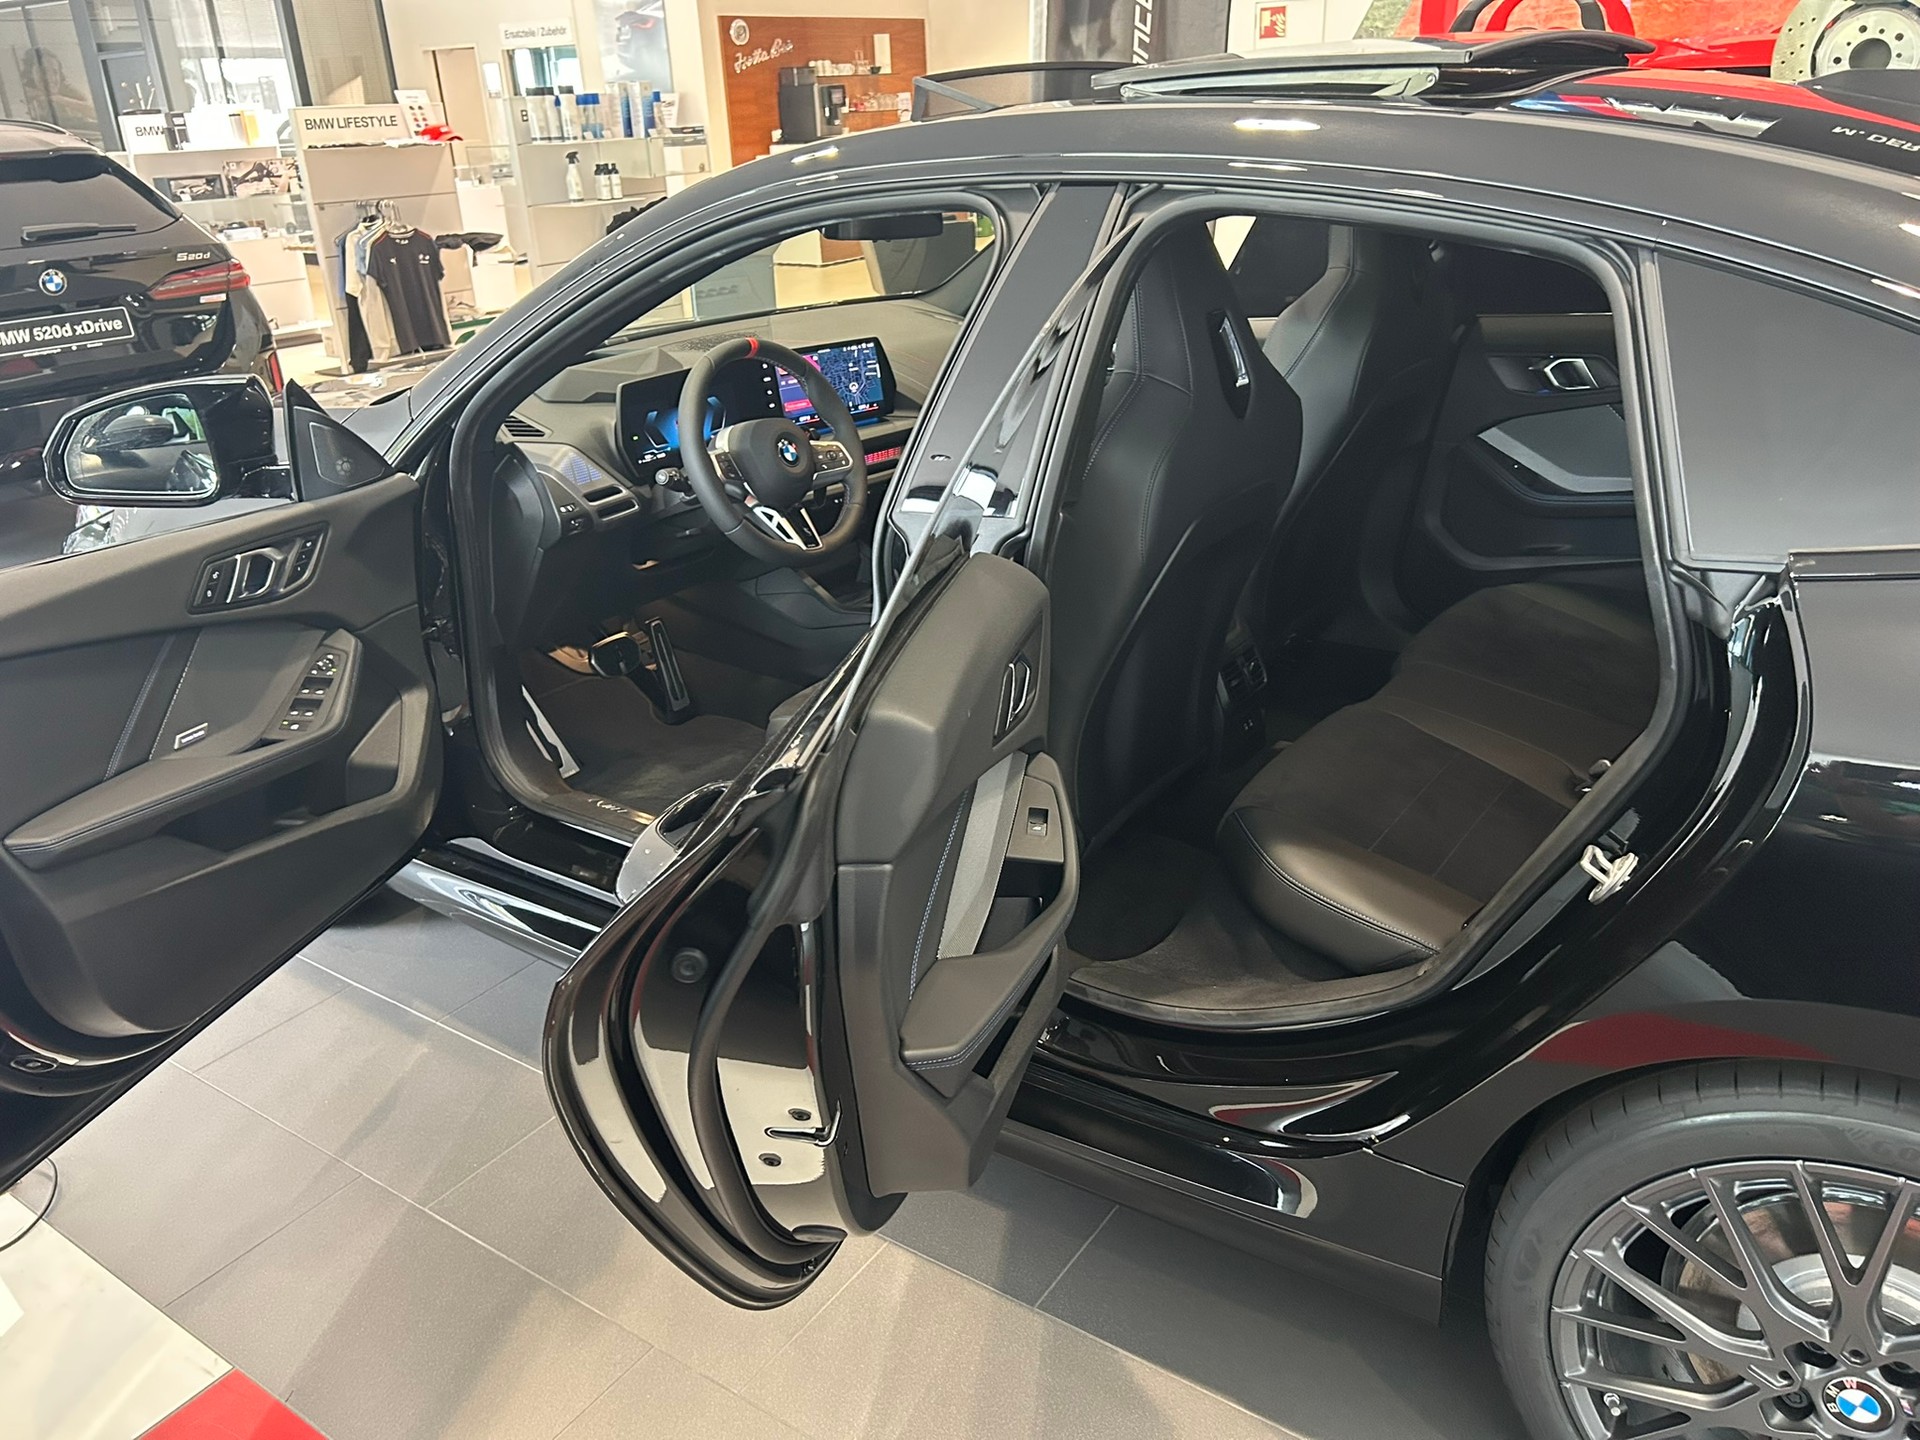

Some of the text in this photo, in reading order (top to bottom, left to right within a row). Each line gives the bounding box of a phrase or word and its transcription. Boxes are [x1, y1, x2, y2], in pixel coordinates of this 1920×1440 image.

[304, 115, 398, 130] BMW LIFESTYLE
[135, 125, 165, 137] BMW
[176, 251, 211, 262] 520d
[0, 318, 123, 347] MW 520d xDrive
[1825, 1378, 1858, 1414] BMW
